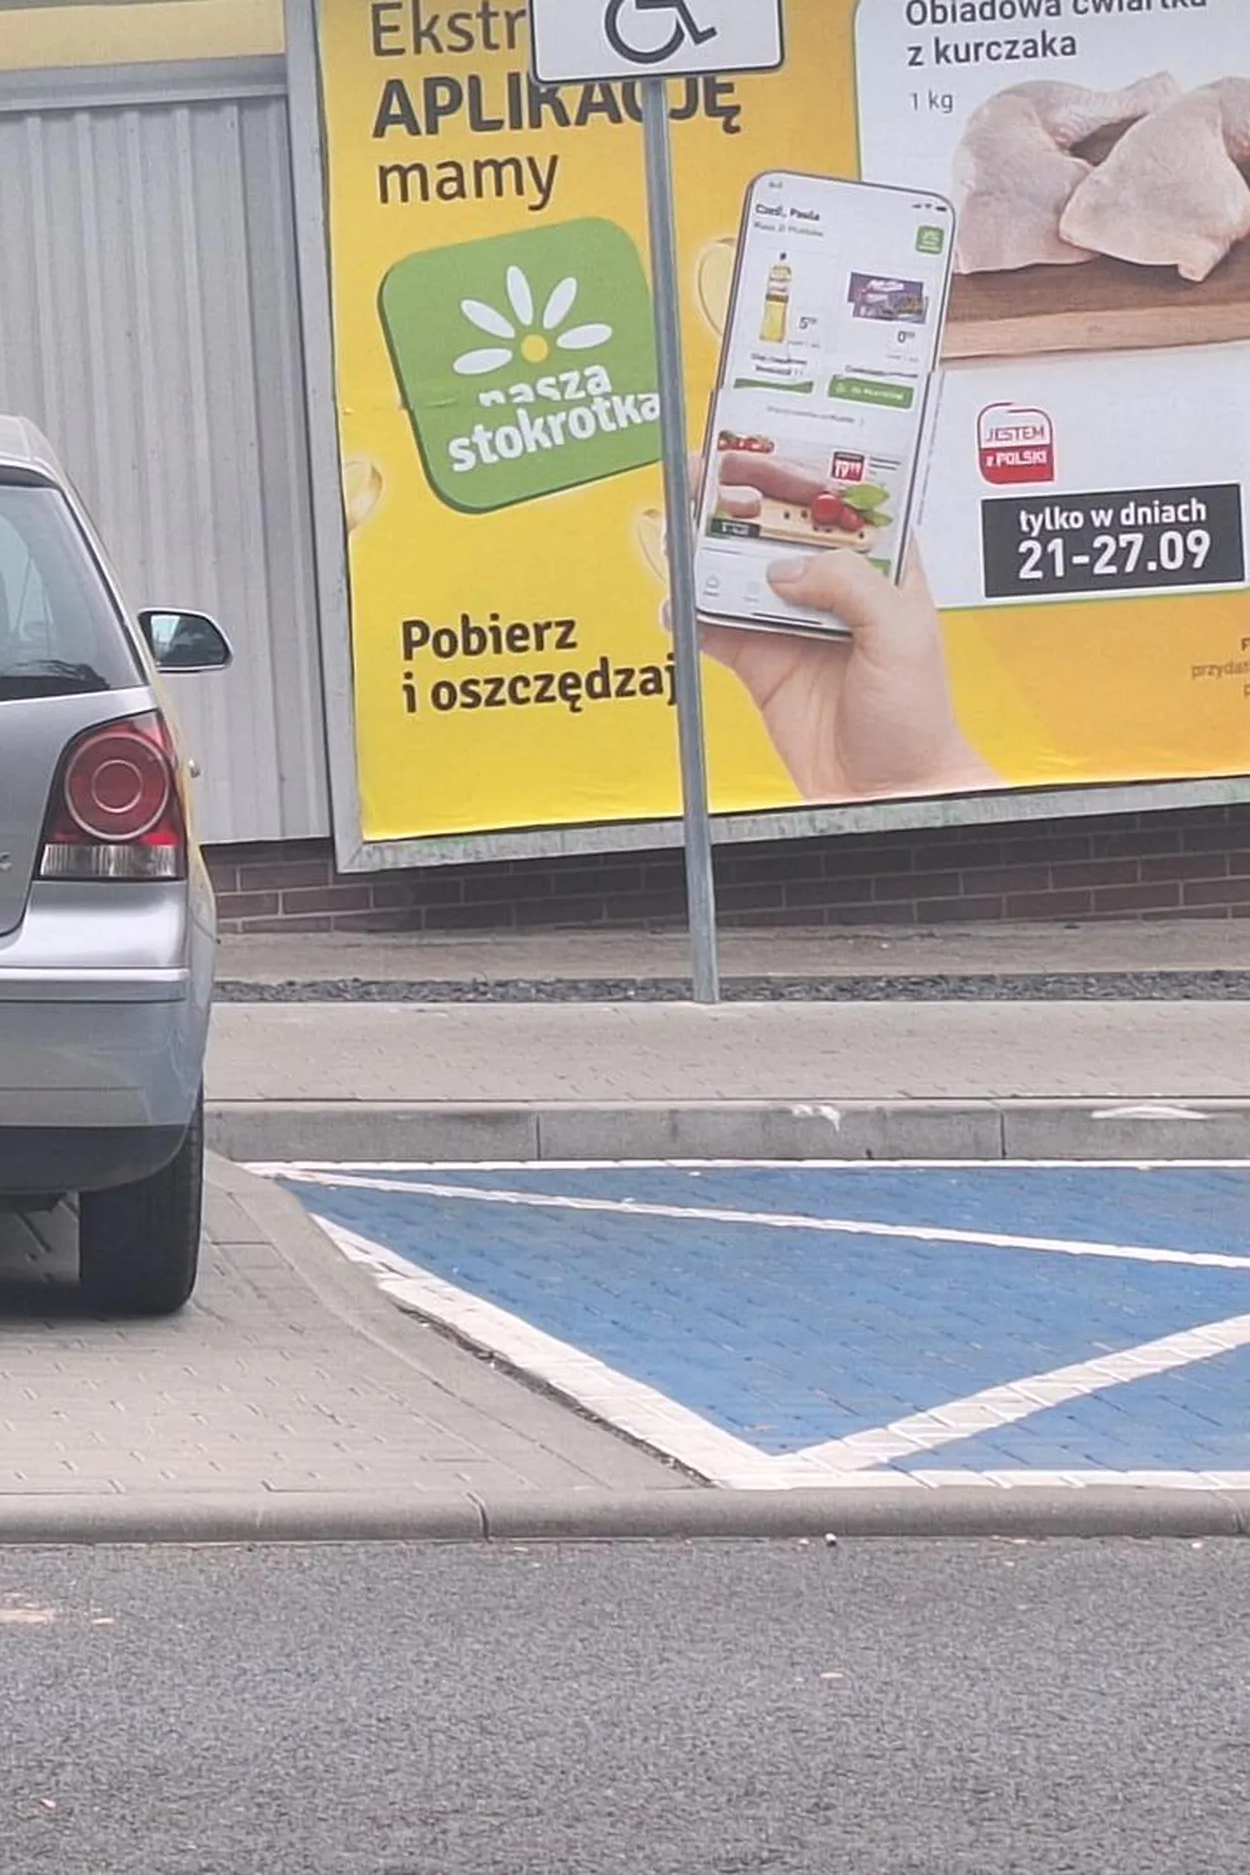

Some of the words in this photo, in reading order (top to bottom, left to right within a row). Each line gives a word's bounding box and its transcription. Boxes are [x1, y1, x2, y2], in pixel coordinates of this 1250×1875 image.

[371, 0, 528, 57] Ekstr
[905, 0, 1062, 26] Obiadowa
[907, 45, 924, 67] z
[934, 29, 1078, 65] kurczaka
[910, 92, 919, 111] 1
[928, 89, 953, 114] kg
[377, 154, 559, 212] mamy
[478, 363, 612, 408] nasza
[448, 392, 661, 472] stokrotka
[985, 425, 1044, 442] JESTEM
[996, 450, 1048, 468] POLSKI
[1018, 506, 1085, 537] tylko
[1090, 508, 1115, 528] w
[1120, 497, 1206, 526] dniach
[1018, 528, 1211, 580] 21-27.09
[401, 613, 578, 661] Pobierz
[402, 671, 417, 713] i
[430, 652, 678, 713] oszczędzaj
